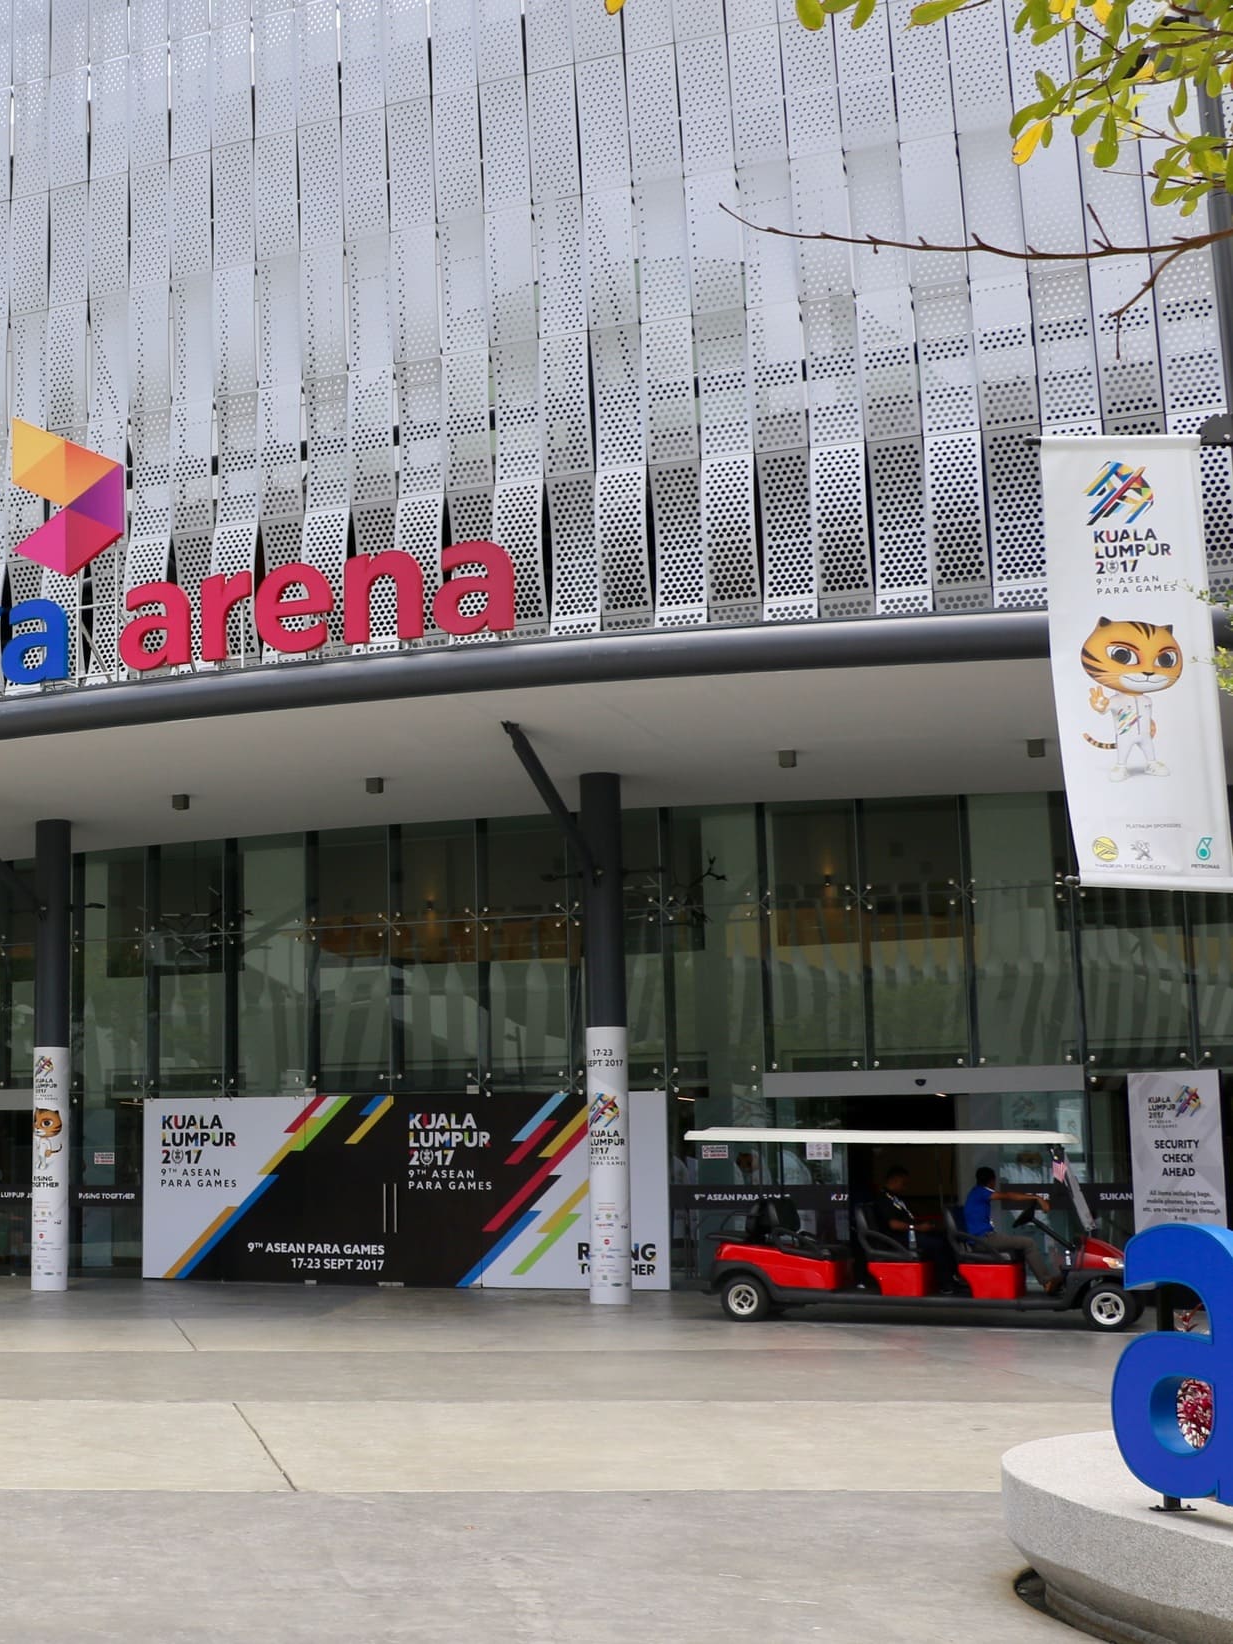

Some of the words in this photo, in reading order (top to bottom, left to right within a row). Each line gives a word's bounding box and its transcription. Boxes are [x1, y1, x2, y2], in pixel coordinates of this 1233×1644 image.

[1093, 528, 1158, 543] KUALA
[1094, 543, 1172, 559] LUMPUR
[1118, 575, 1159, 584] ASEAN
[1096, 586, 1129, 595] PARA
[1136, 584, 1177, 593] GAMES
[119, 540, 516, 670] arena
[592, 1048, 613, 1056] 17-23
[162, 1115, 222, 1130] KUALA
[408, 1113, 477, 1129] KUALA
[162, 1132, 236, 1146] LUMPUR
[408, 1132, 492, 1148] LUMPUR
[1154, 1140, 1200, 1149] SECURITY
[1162, 1154, 1194, 1163] CHECK
[161, 1168, 177, 1176] 9TH
[182, 1168, 220, 1176] ASEAN
[408, 1170, 426, 1178] 9TH
[432, 1170, 474, 1178] ASEAN
[1162, 1168, 1196, 1176] AHEAD
[161, 1179, 191, 1188] PARA
[198, 1179, 237, 1188] GAMES
[408, 1181, 442, 1190] PARA
[448, 1181, 492, 1190] GAMES
[248, 1242, 263, 1252] 9TH
[266, 1243, 305, 1253] ASEAN
[308, 1244, 340, 1254] PARA
[343, 1244, 385, 1255] GAMES
[291, 1258, 320, 1269] 17-23
[324, 1258, 354, 1270] SEPT
[356, 1260, 384, 1270] 2017
